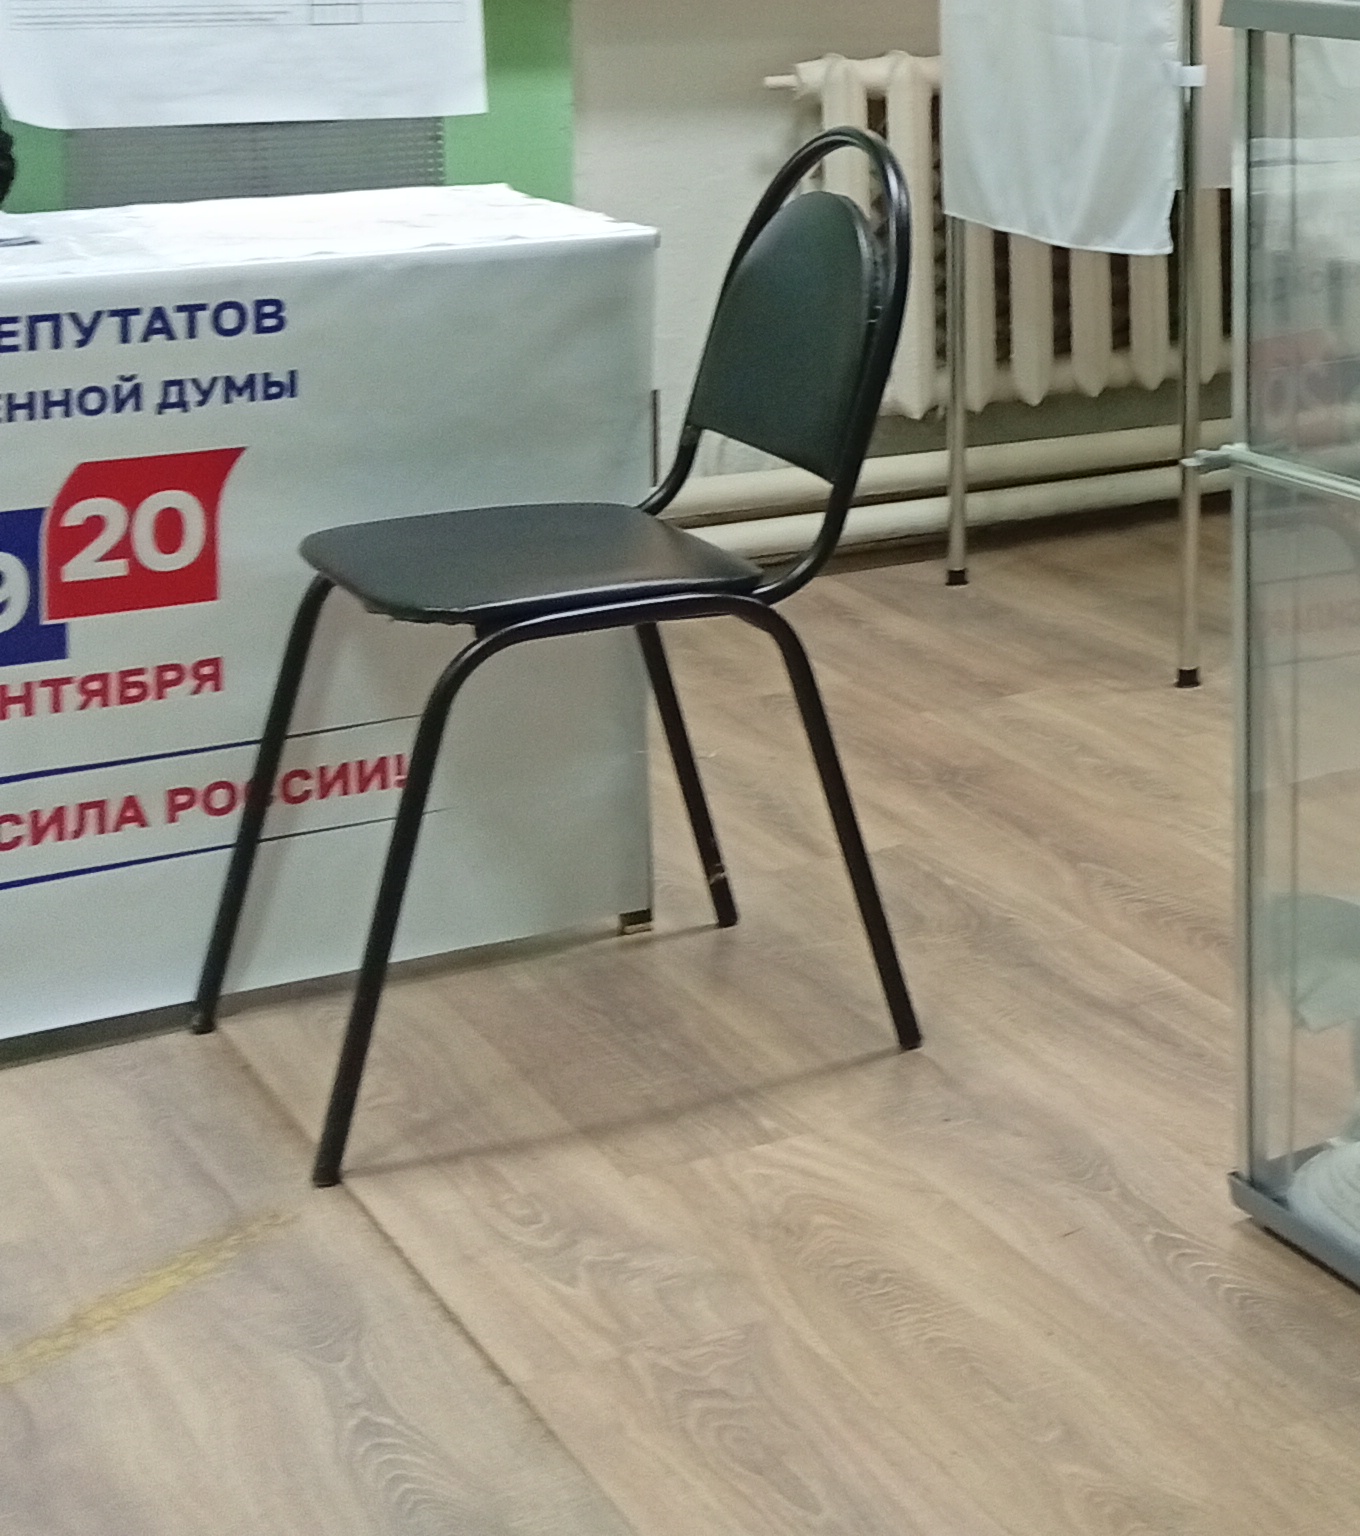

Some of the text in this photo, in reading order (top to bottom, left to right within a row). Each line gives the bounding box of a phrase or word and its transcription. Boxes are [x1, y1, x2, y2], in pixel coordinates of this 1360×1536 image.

[0, 368, 299, 423] ННОЙ ДУМЫ
[60, 489, 208, 583] 20
[0, 795, 150, 852] СИЛА
